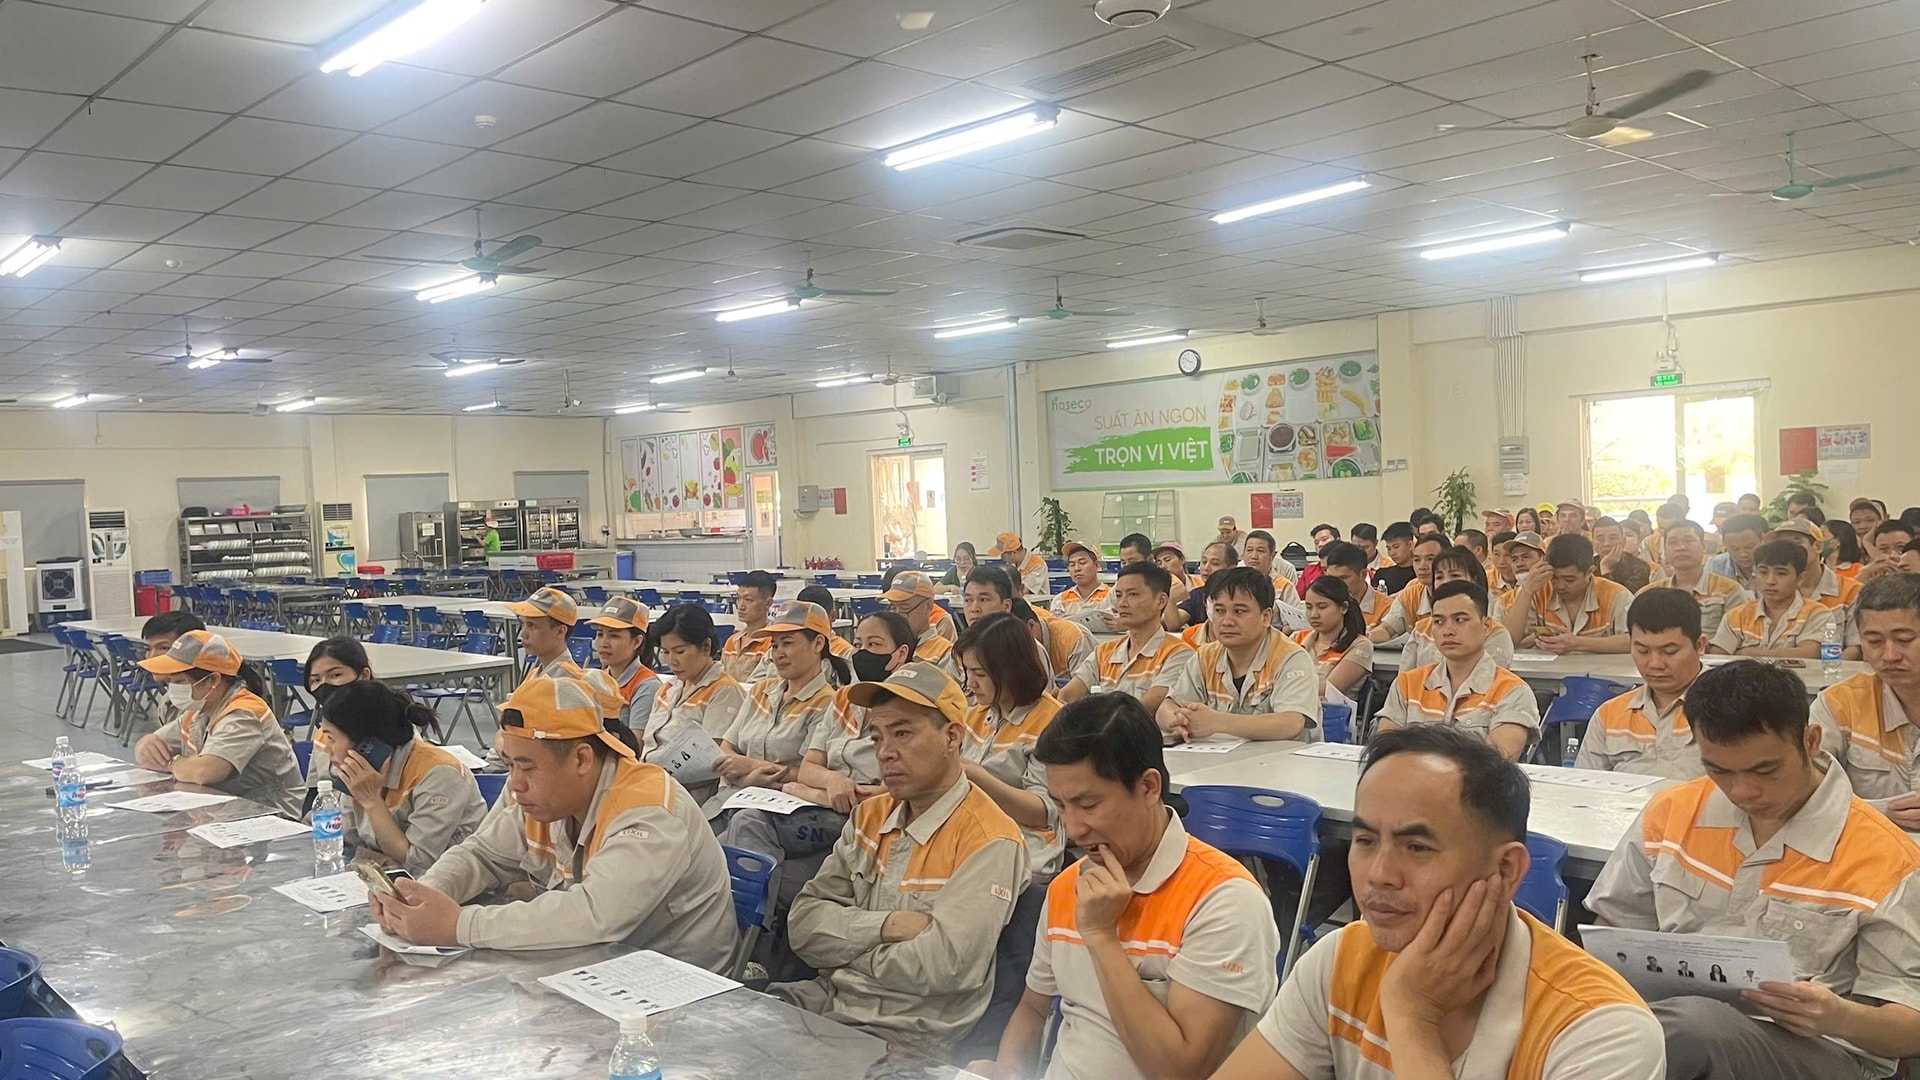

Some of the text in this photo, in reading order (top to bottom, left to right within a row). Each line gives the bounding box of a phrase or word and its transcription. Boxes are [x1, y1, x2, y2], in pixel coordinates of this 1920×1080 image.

[1095, 406, 1207, 431] SUẤT ĂN NGON
[1094, 437, 1208, 468] TRỌN VỊ VIỆT
[797, 825, 824, 842] SN
